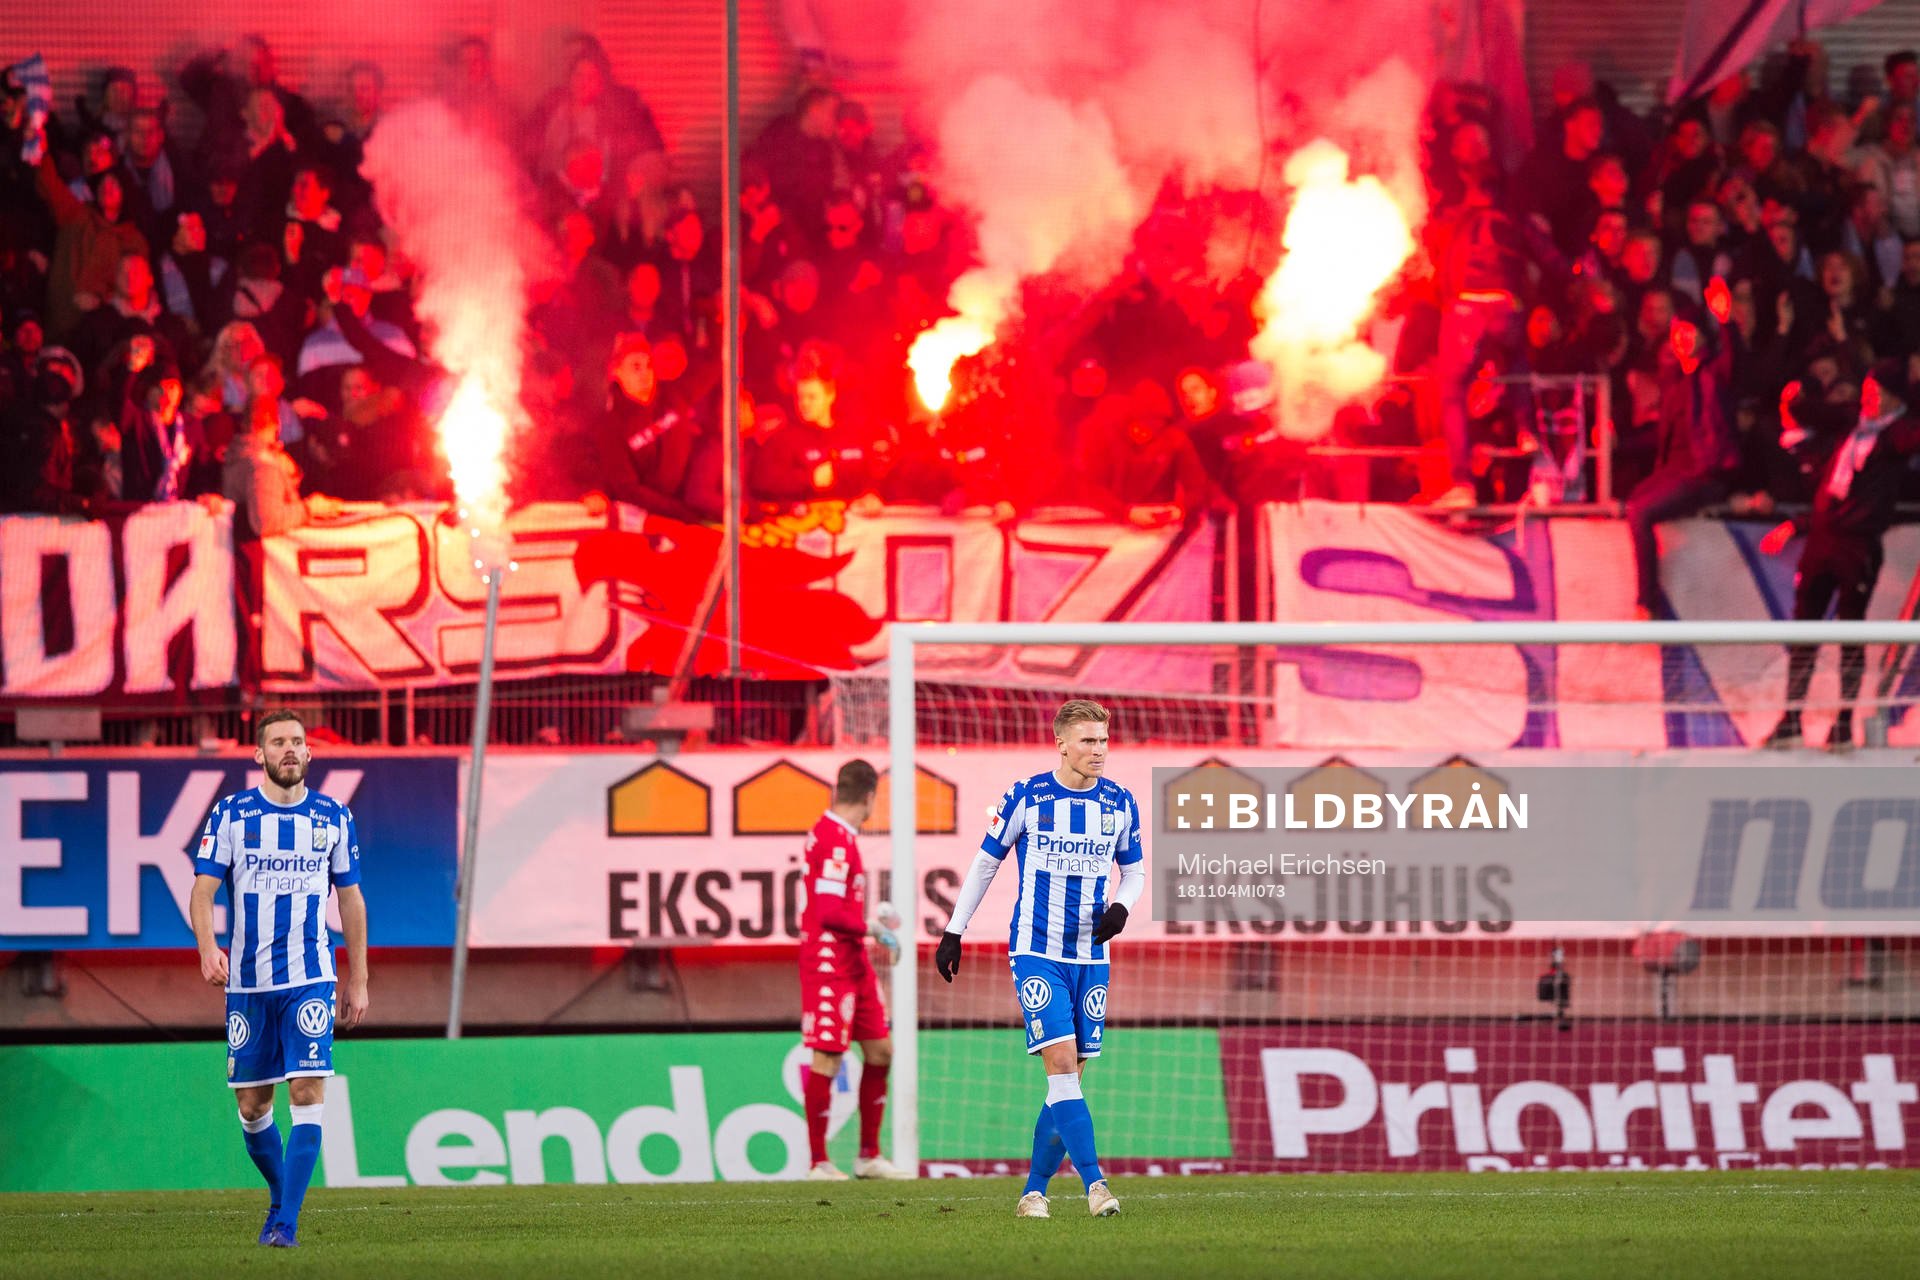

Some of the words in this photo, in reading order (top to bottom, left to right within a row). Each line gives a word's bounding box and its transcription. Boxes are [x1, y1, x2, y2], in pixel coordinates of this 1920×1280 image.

[1037, 833, 1111, 856] Prioritet
[246, 854, 323, 872] Prioritet
[1046, 852, 1100, 873] Finans
[254, 872, 311, 892] Finans
[1091, 1025, 1102, 1041] 4
[308, 1041, 319, 1060] 2
[1260, 1046, 1918, 1159] Prioritet
[322, 1065, 813, 1188] Lendo
